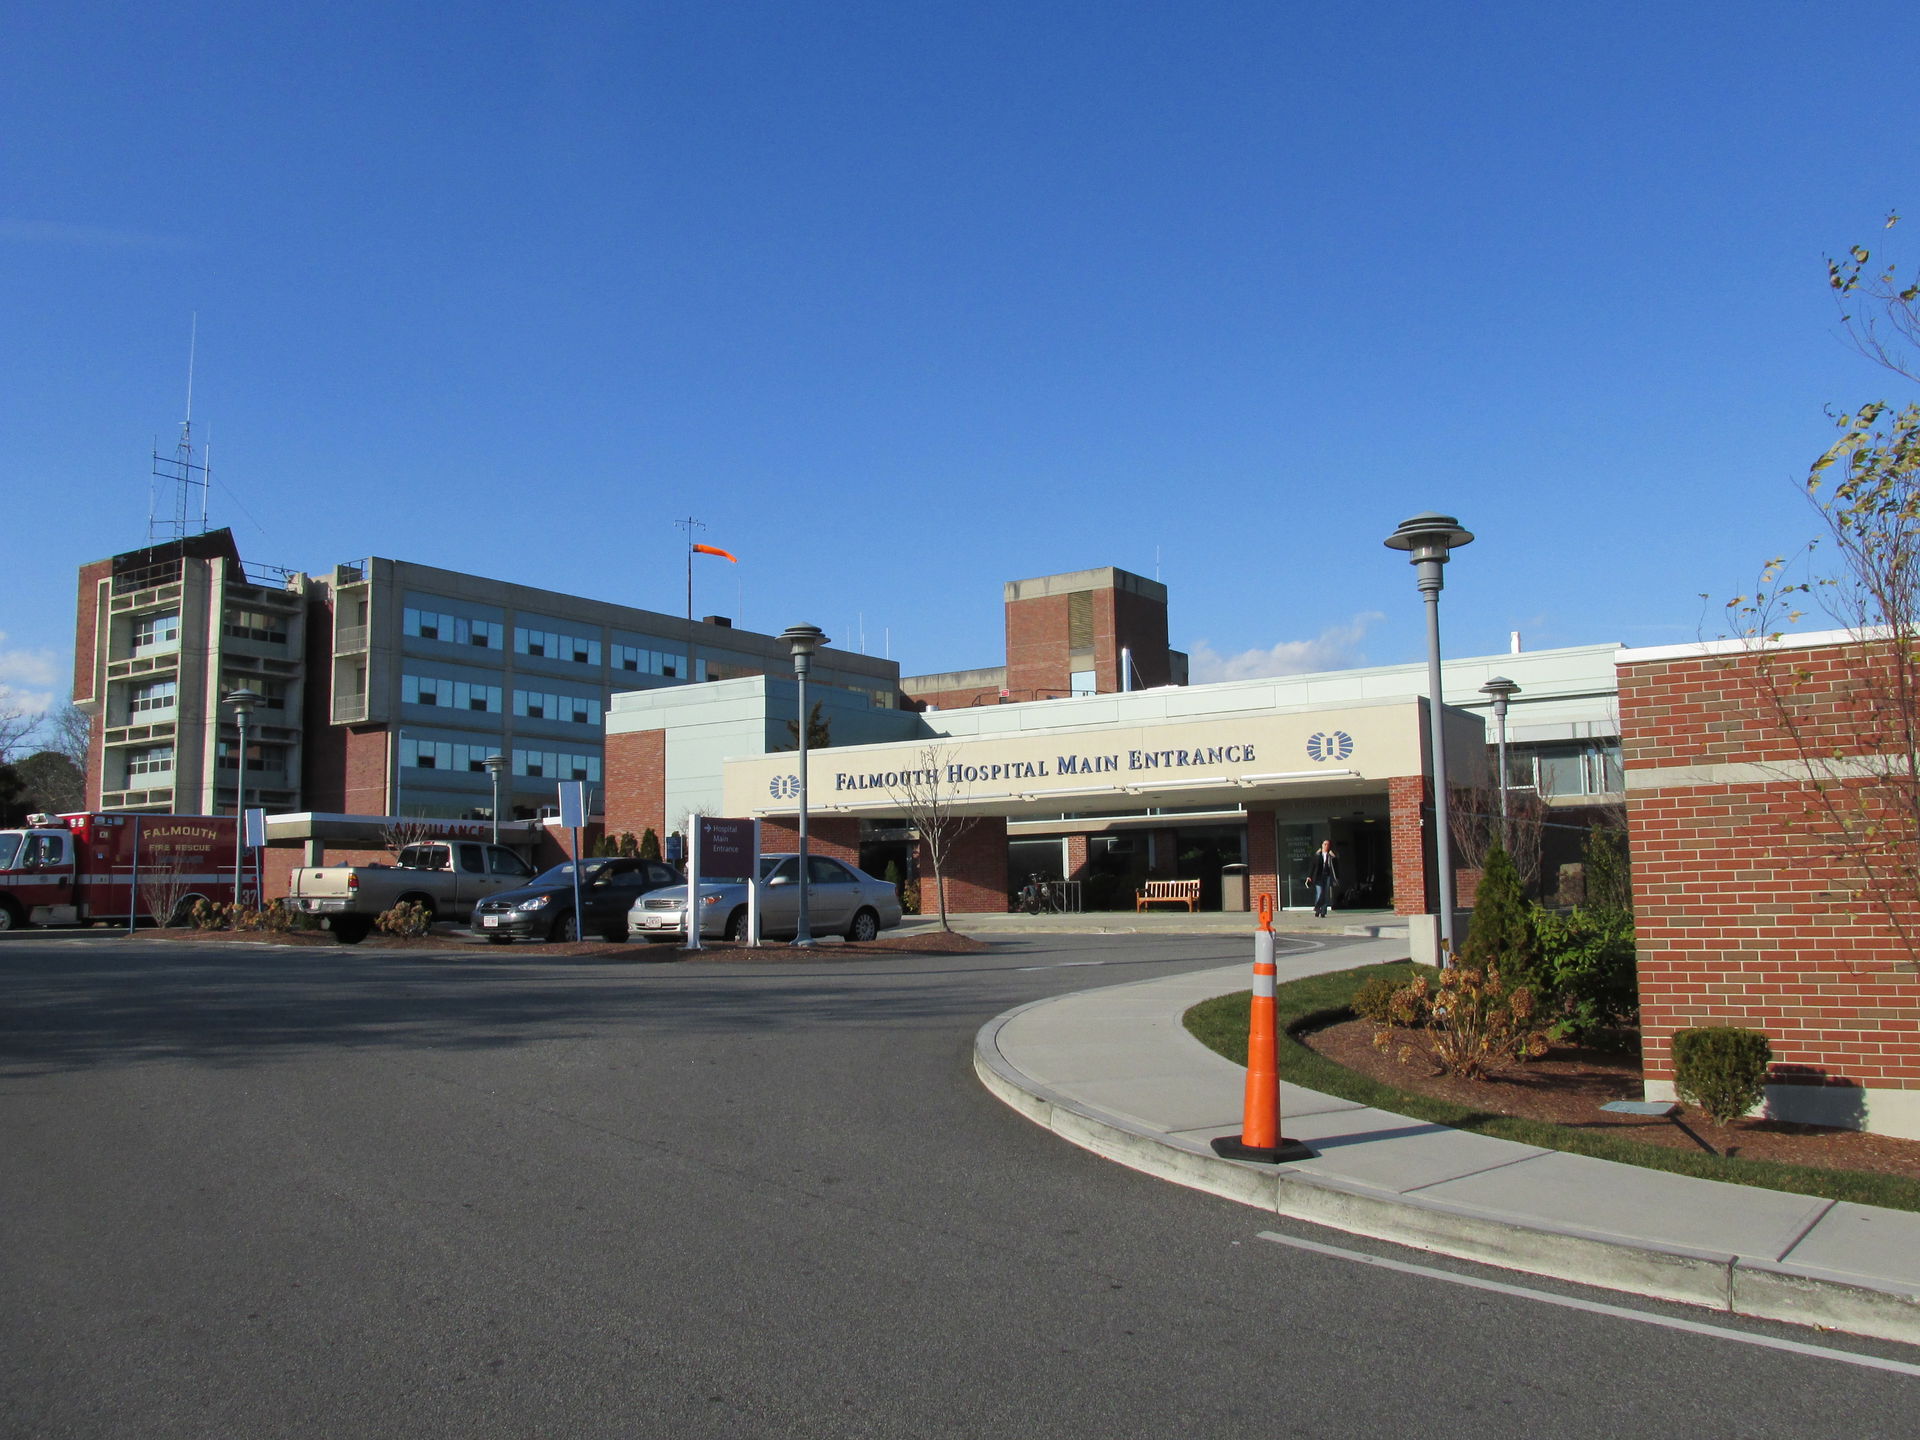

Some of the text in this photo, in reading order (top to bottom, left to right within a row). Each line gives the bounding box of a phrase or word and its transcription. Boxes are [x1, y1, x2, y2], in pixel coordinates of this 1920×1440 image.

[836, 744, 1256, 791] FALMOUTH HOSPITAL MAIN ENTRANCE
[143, 826, 217, 840] FALMOUTH
[713, 825, 738, 833] Hospital
[149, 844, 211, 852] FIRE RESCUE
[713, 845, 739, 853] Entrance
[242, 889, 257, 905] 37
